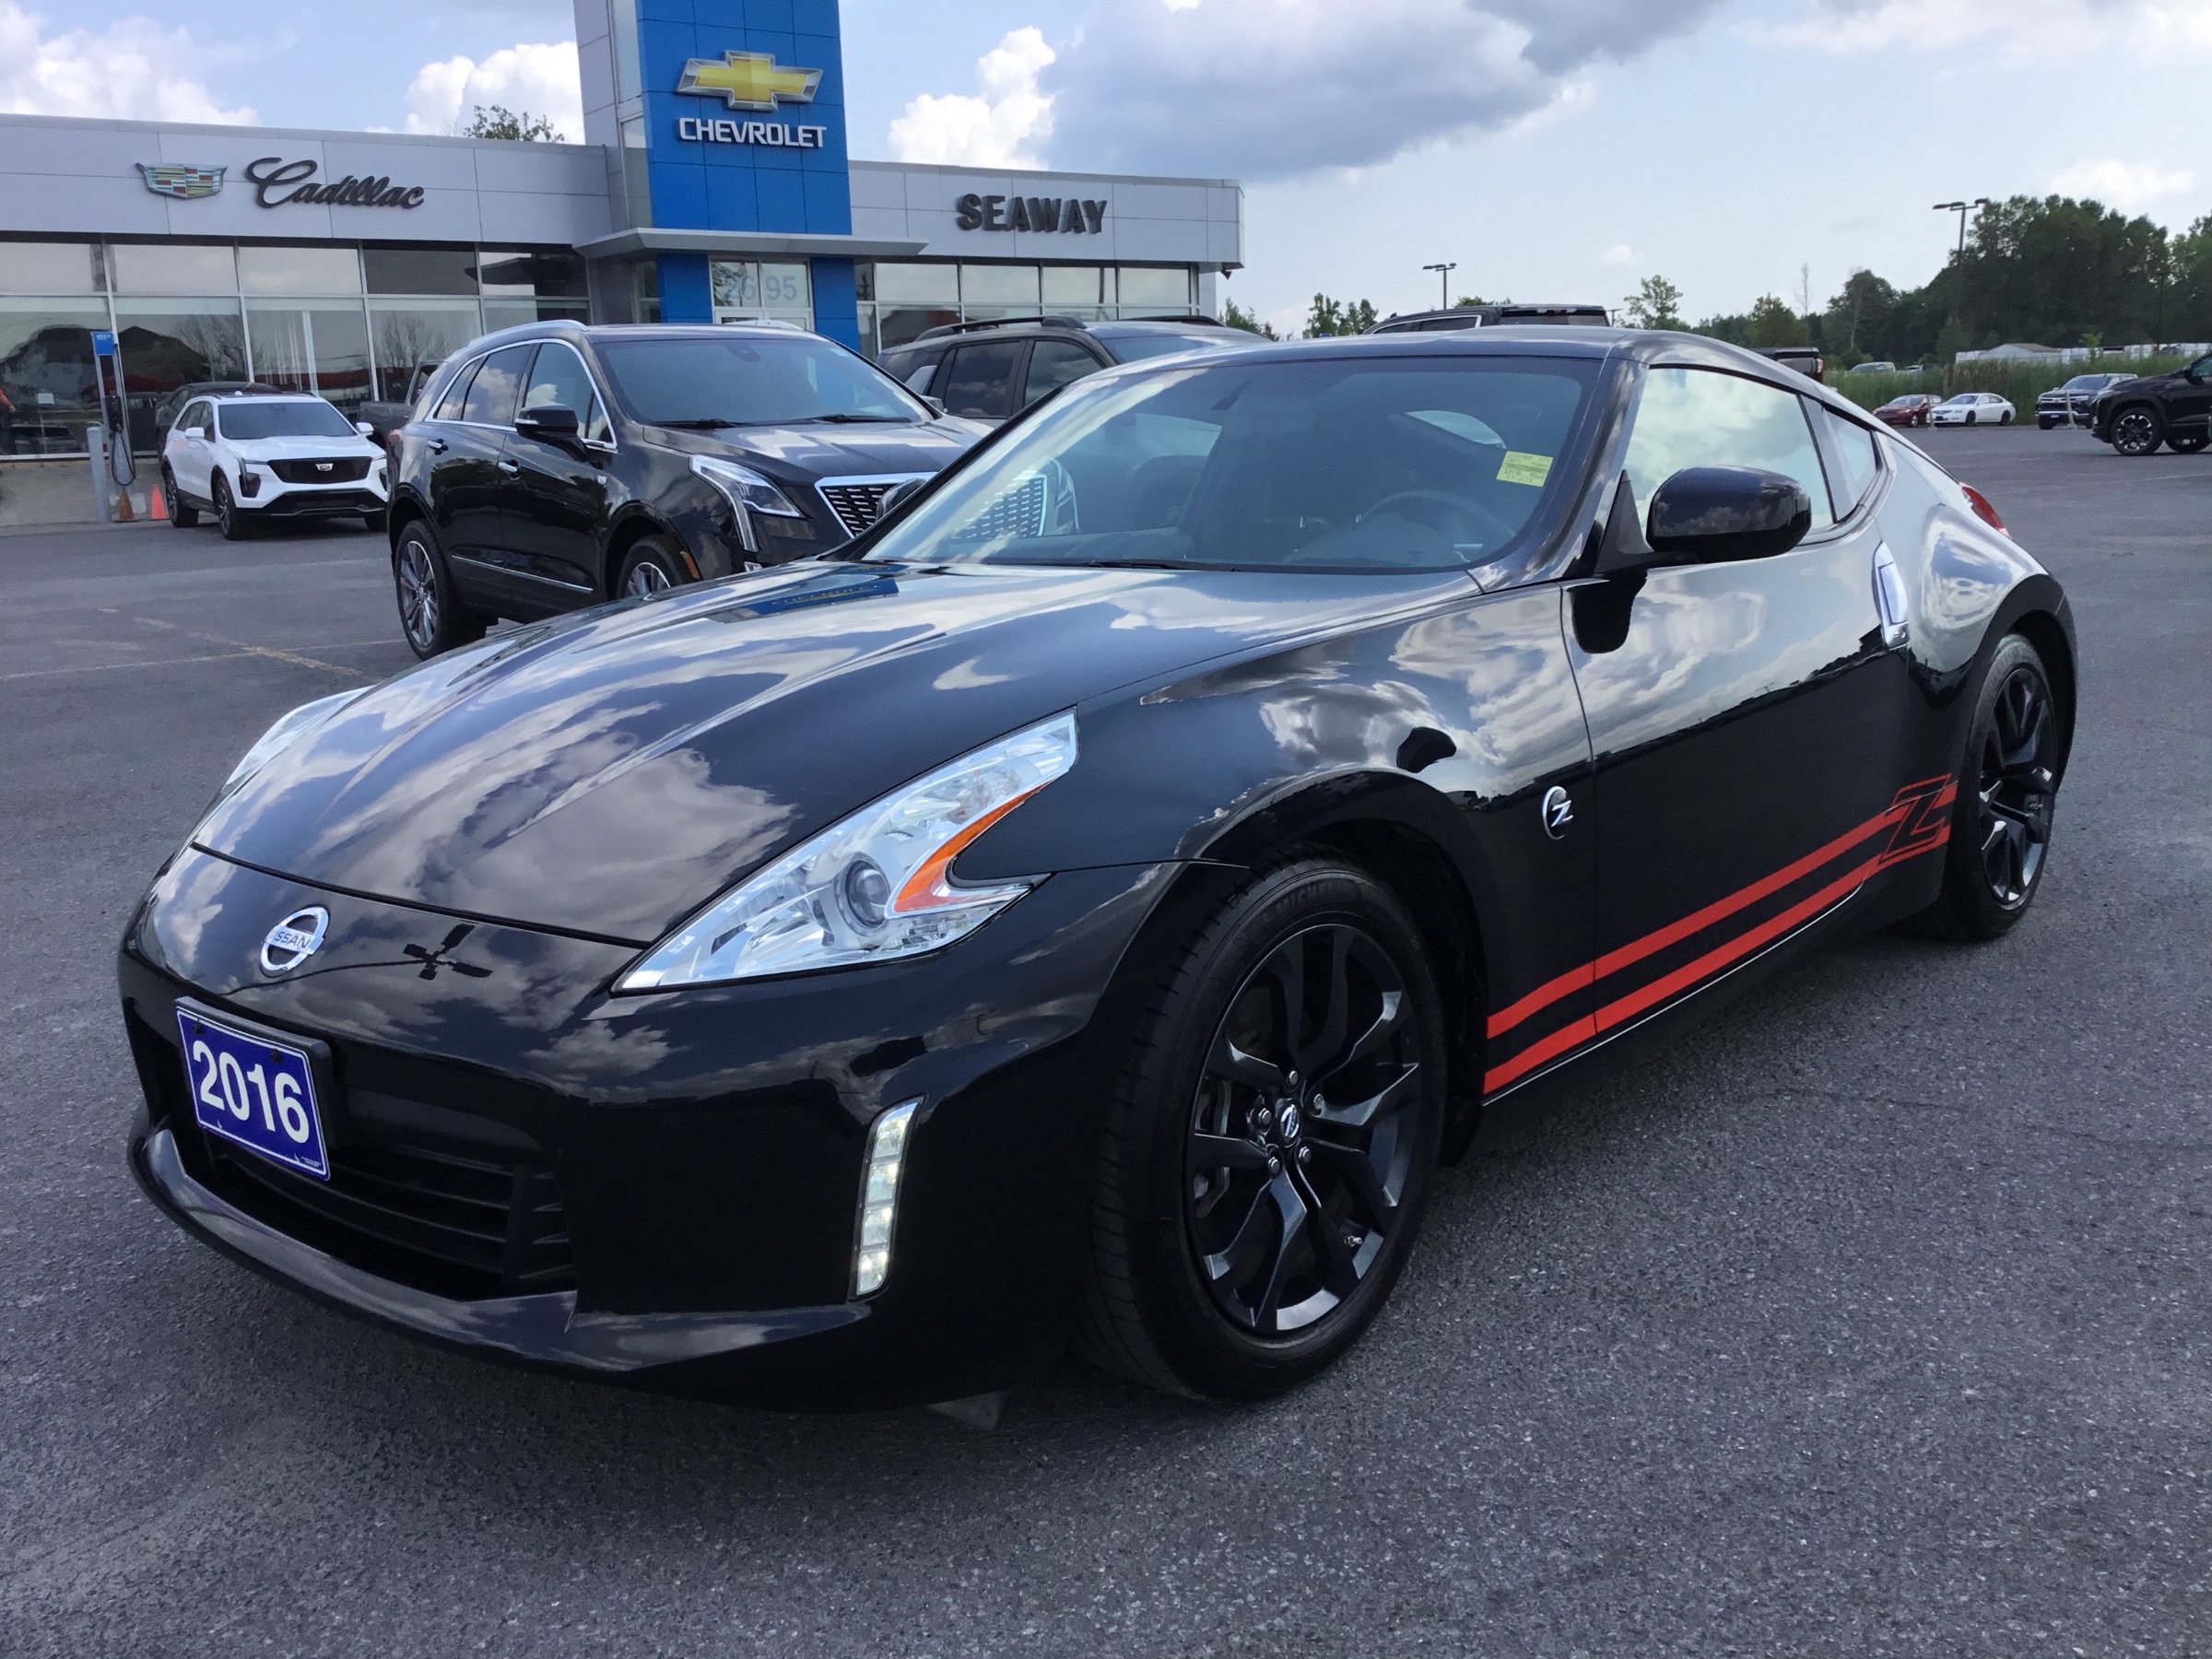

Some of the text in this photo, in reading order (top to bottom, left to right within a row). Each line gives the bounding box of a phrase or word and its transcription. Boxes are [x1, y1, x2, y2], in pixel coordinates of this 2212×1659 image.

[679, 117, 827, 147] CHEVROLET
[245, 157, 425, 208] Cadillac
[956, 193, 1108, 234] SEAWAY
[267, 925, 312, 949] ISSAN
[193, 1040, 310, 1144] 2016
